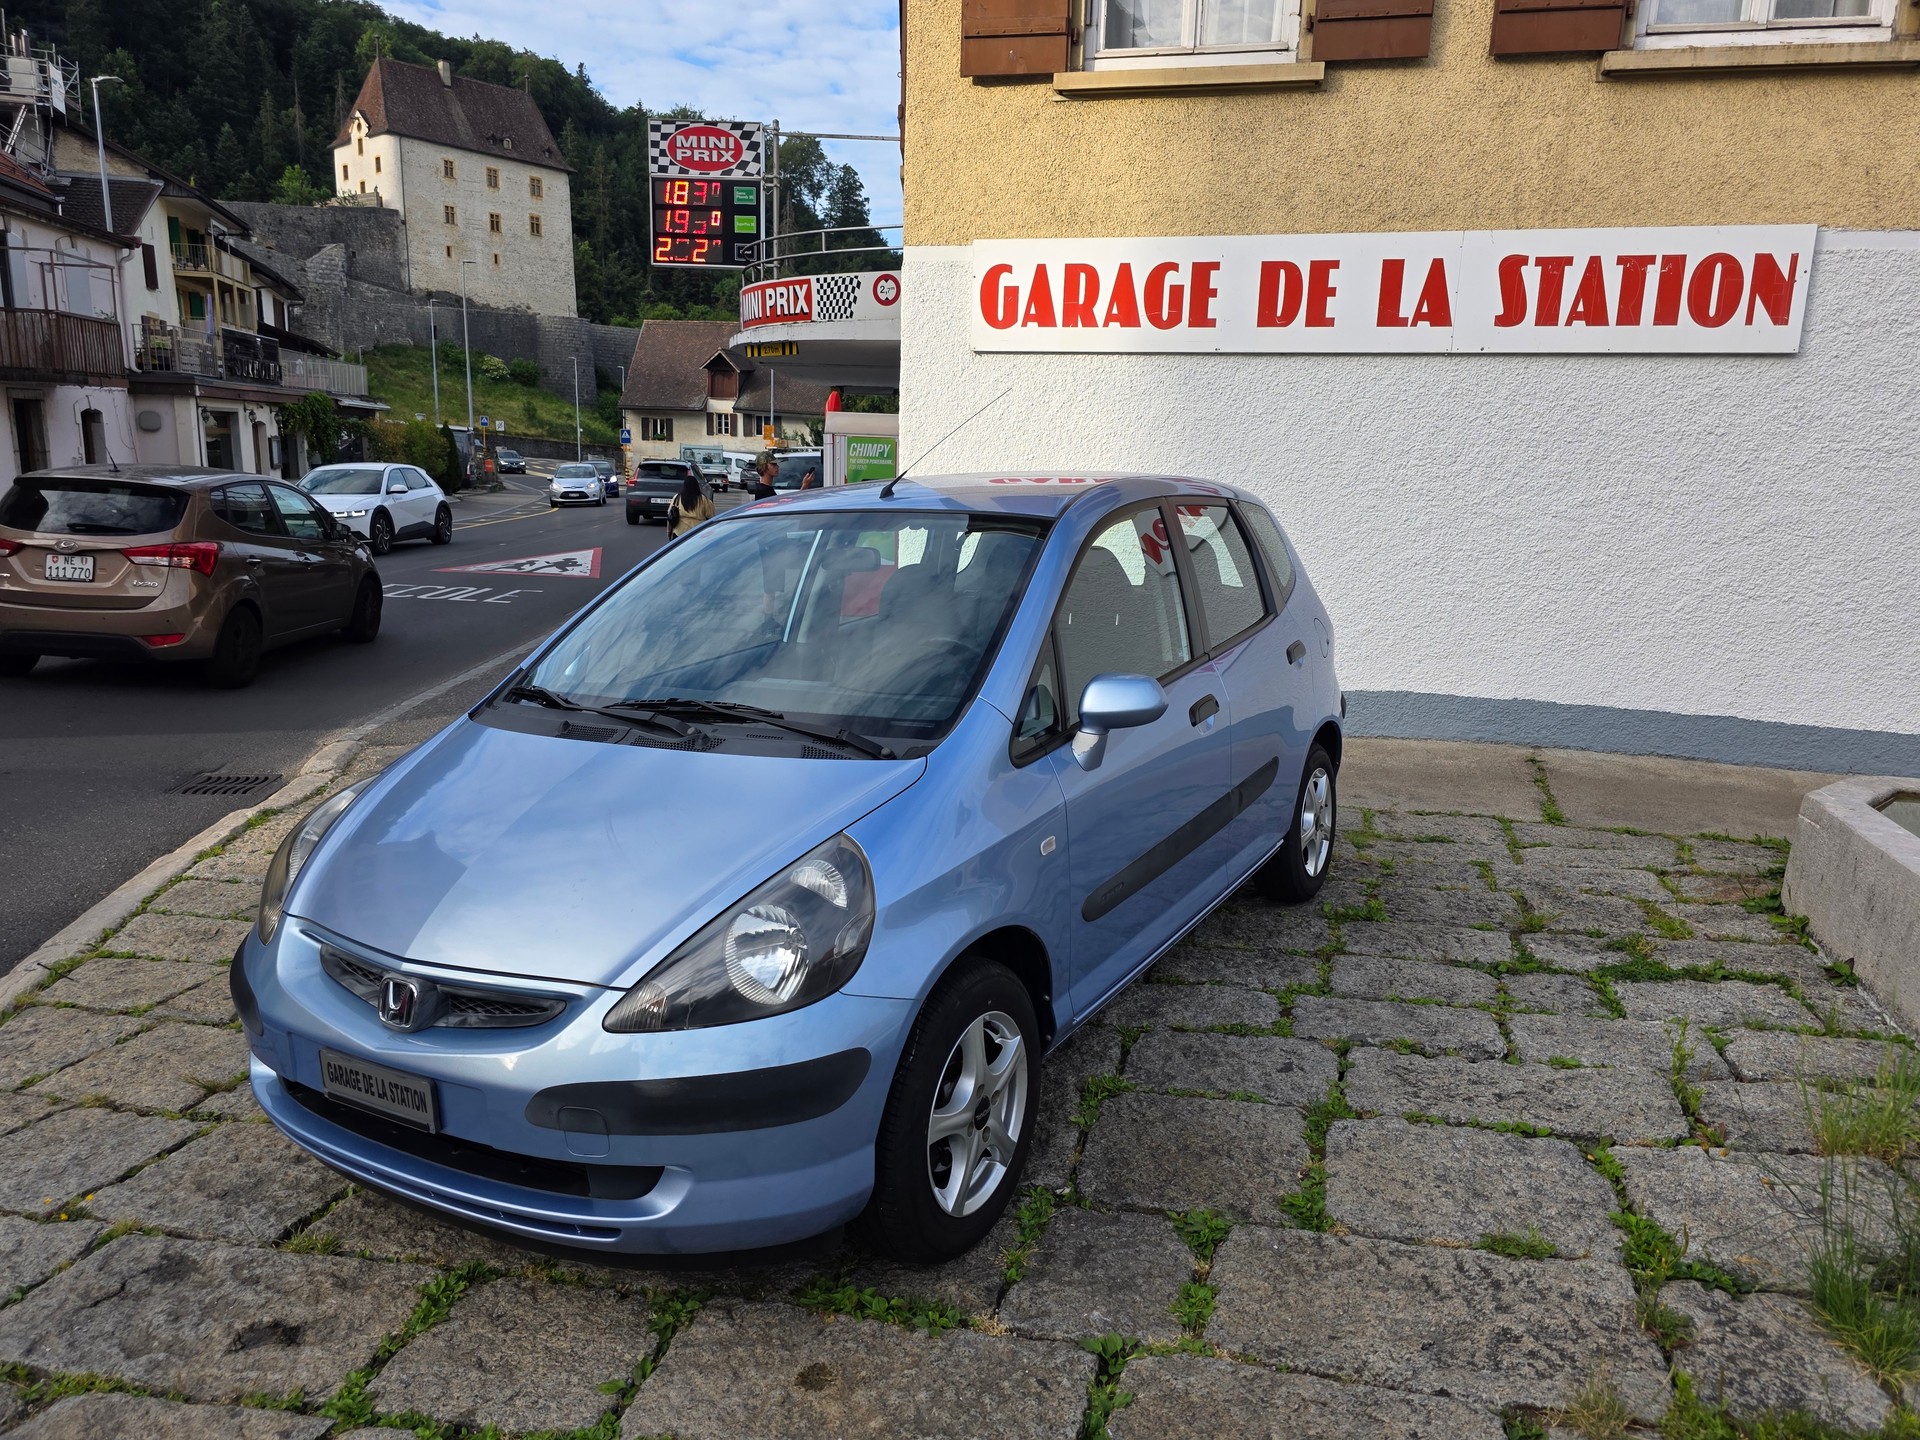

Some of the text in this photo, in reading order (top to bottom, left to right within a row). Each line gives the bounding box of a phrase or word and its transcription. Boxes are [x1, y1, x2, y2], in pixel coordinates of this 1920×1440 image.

[675, 135, 735, 149] MINI
[676, 149, 735, 162] PRIX
[980, 252, 1799, 330] GARAGE DE LA STATION
[765, 284, 809, 318] PRIX
[850, 443, 891, 457] CHIMPY
[64, 556, 75, 566] NE
[327, 1061, 428, 1113] GARAGE DE LA STATION
